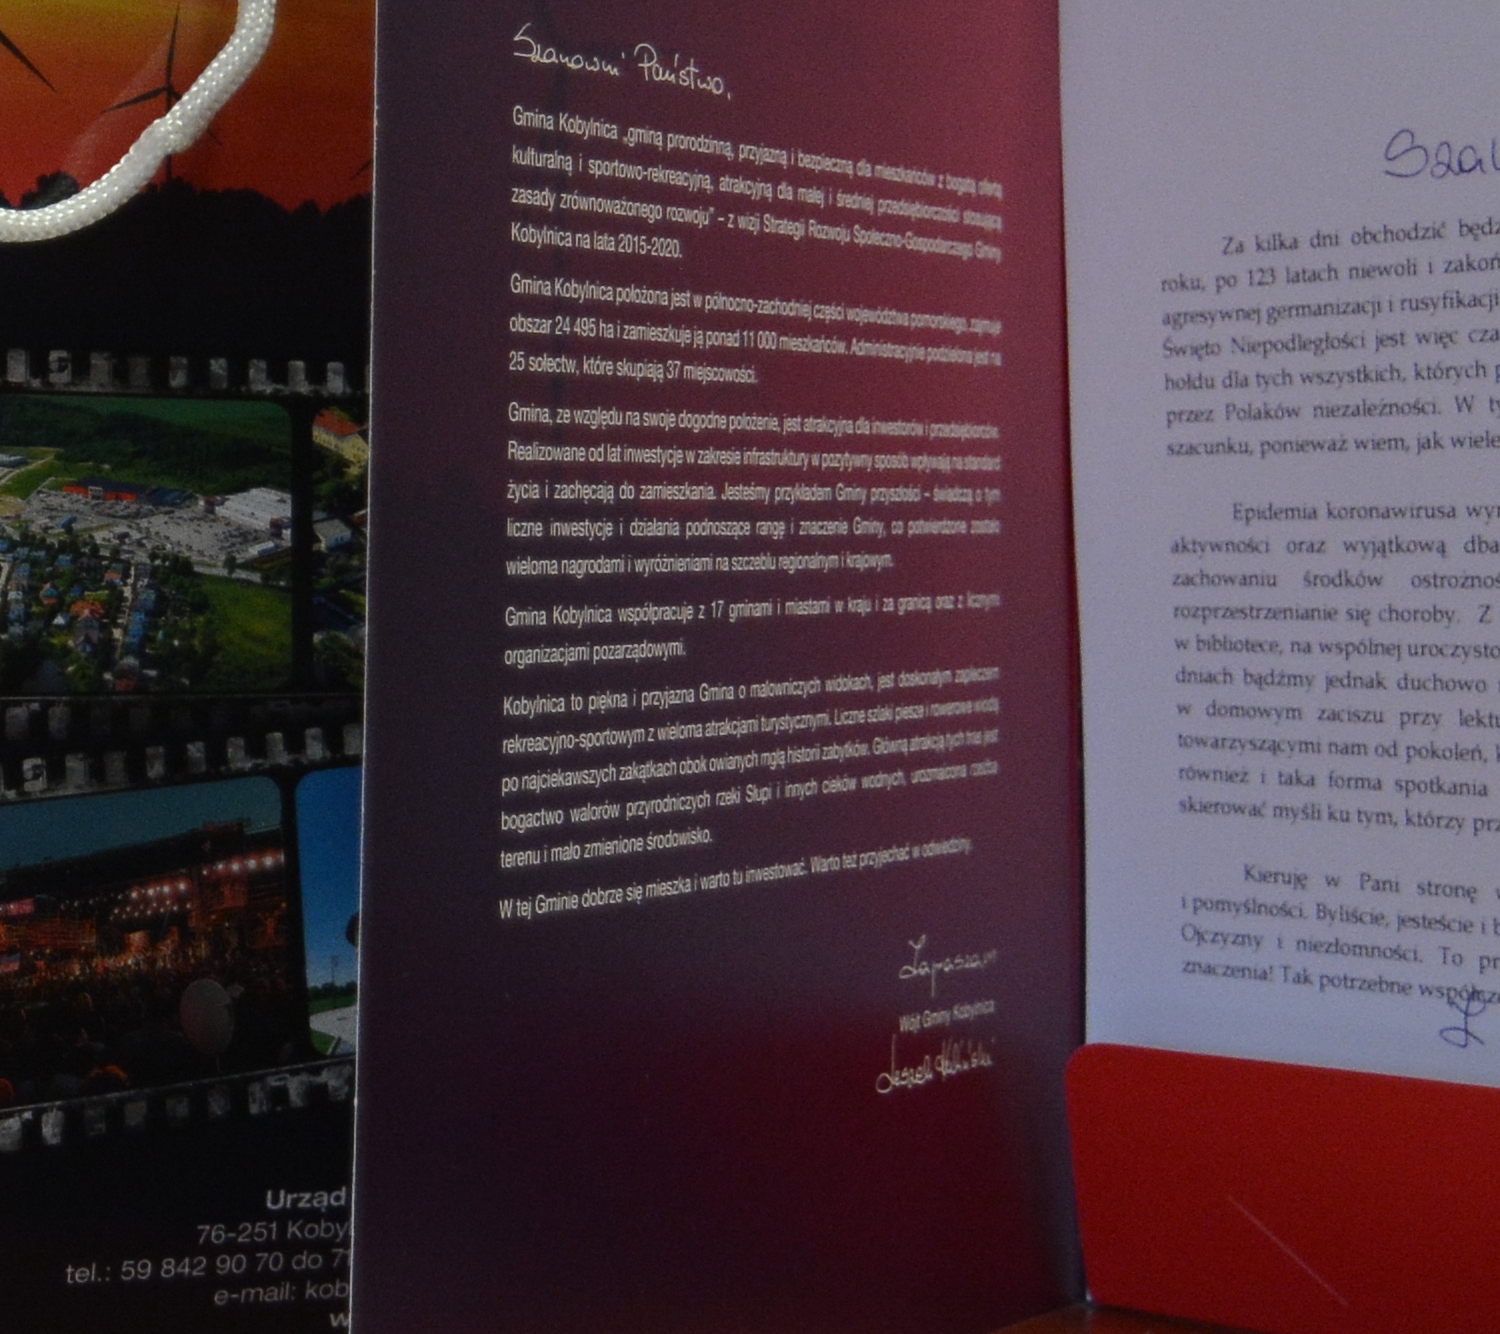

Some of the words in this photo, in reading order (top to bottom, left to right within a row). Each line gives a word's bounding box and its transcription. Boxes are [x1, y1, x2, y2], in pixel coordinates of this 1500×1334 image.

[512, 104, 556, 133] Gmina
[559, 112, 620, 142] Kobylnica
[511, 222, 575, 251] Kobylnica
[575, 233, 593, 252] na
[593, 232, 618, 254] lata
[617, 234, 684, 261] 2015-2020.
[1222, 236, 1247, 257] Za
[1255, 232, 1301, 254] kilka
[1310, 230, 1342, 251] dni
[1351, 221, 1448, 247] obchodzić
[1161, 273, 1207, 294] roku,
[1215, 274, 1240, 296] po
[1248, 267, 1278, 288] 123
[1286, 263, 1341, 286] latach
[1349, 258, 1419, 282] niewoli
[1233, 502, 1320, 528] Epidemia
[1326, 502, 1459, 522] koronawirusa
[1171, 536, 1272, 556] aktywności
[1286, 540, 1328, 556] oraz
[1343, 536, 1449, 560] wyjątkową
[1172, 569, 1279, 590] zachowaniu
[1303, 570, 1385, 590] środków
[505, 606, 549, 629] Gmina
[552, 604, 615, 630] Kobylnica
[617, 602, 696, 627] współpracuje
[711, 599, 726, 619] 17
[266, 1186, 346, 1214] Urząd
[197, 1220, 279, 1246] 76-251
[287, 1217, 353, 1242] Koby
[66, 1262, 112, 1285] tel.:
[120, 1259, 153, 1281] 59
[160, 1256, 207, 1278] 842
[215, 1253, 248, 1275] 90
[255, 1250, 285, 1272] 70
[291, 1249, 323, 1271] do
[213, 1282, 298, 1307] e-mail:
